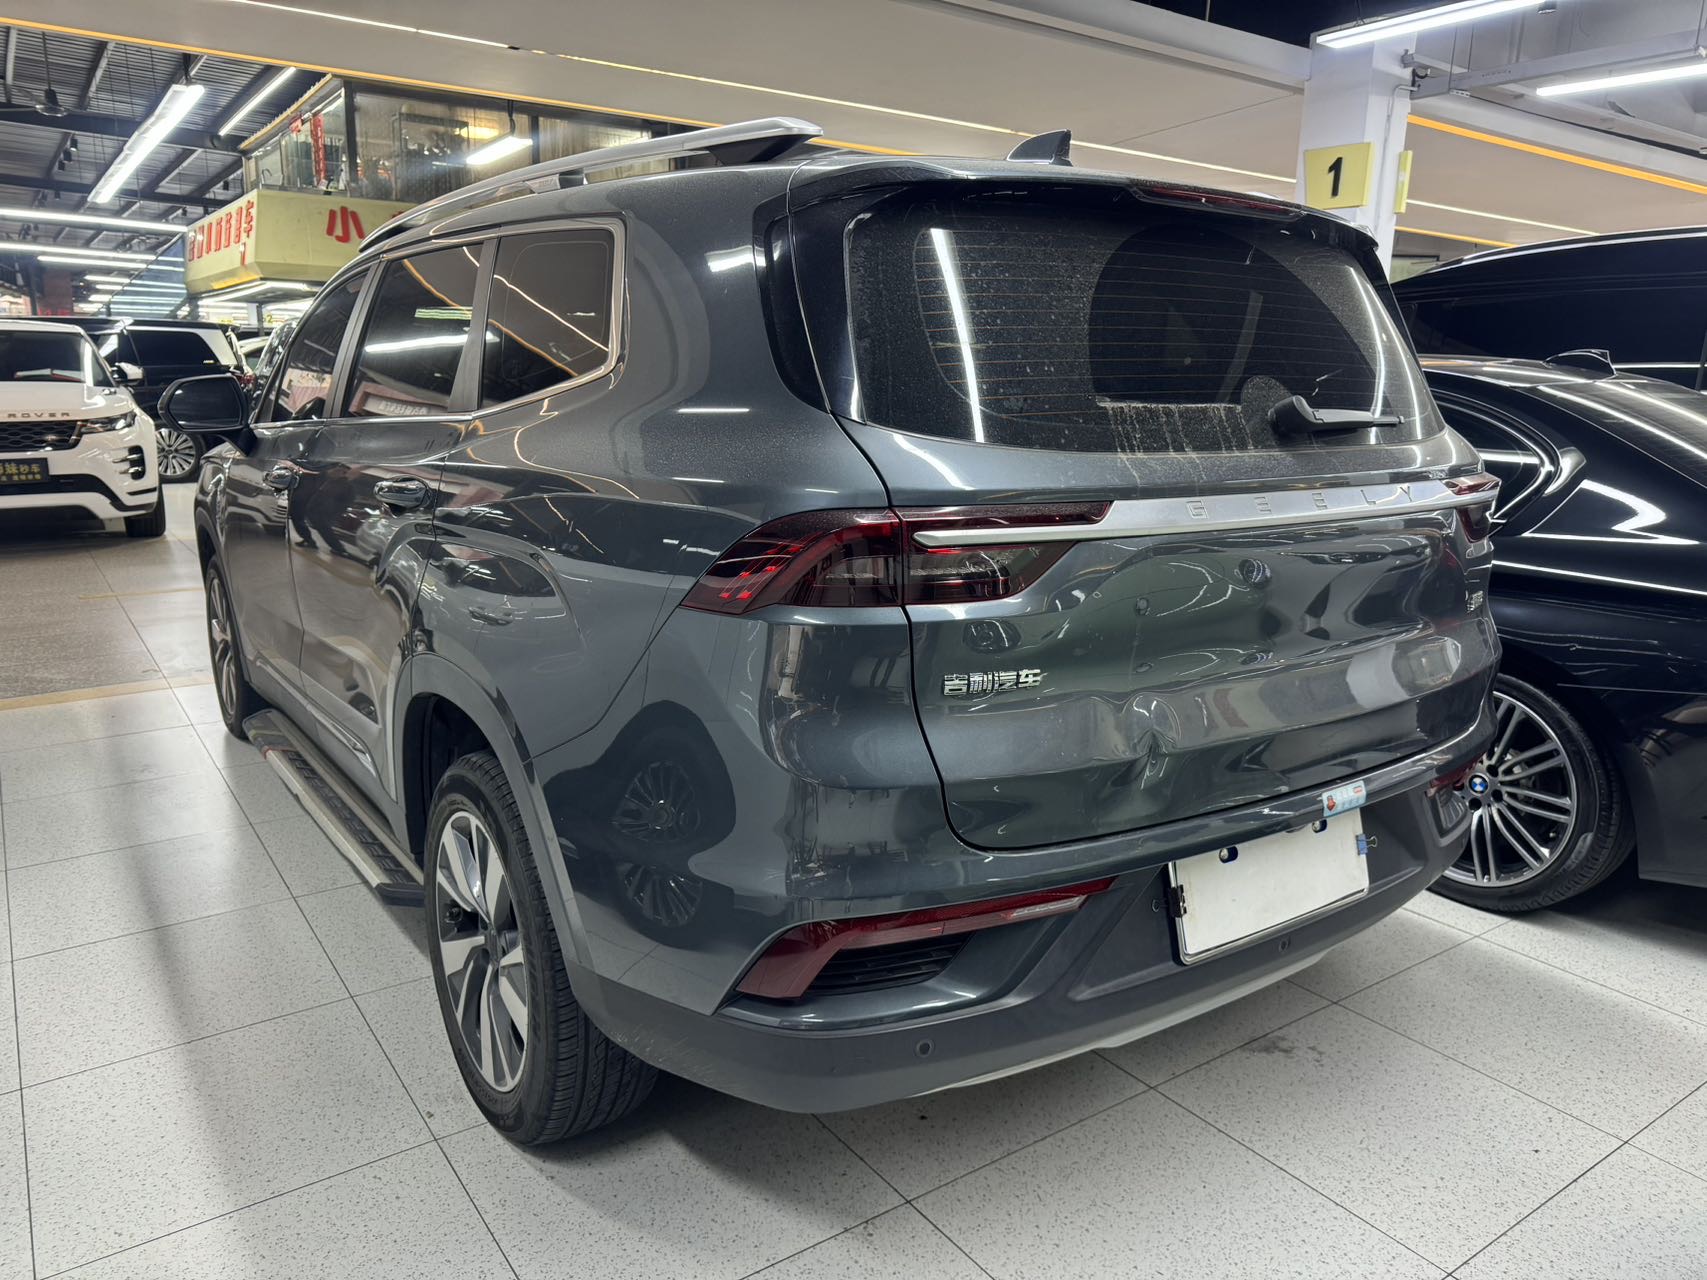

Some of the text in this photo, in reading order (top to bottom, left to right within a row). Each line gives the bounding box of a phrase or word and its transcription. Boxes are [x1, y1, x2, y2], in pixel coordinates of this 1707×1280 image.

[1327, 156, 1343, 198] 1
[326, 206, 366, 243] 小
[1186, 485, 1412, 519] GEELY
[944, 668, 1040, 696] 吉利汽车
